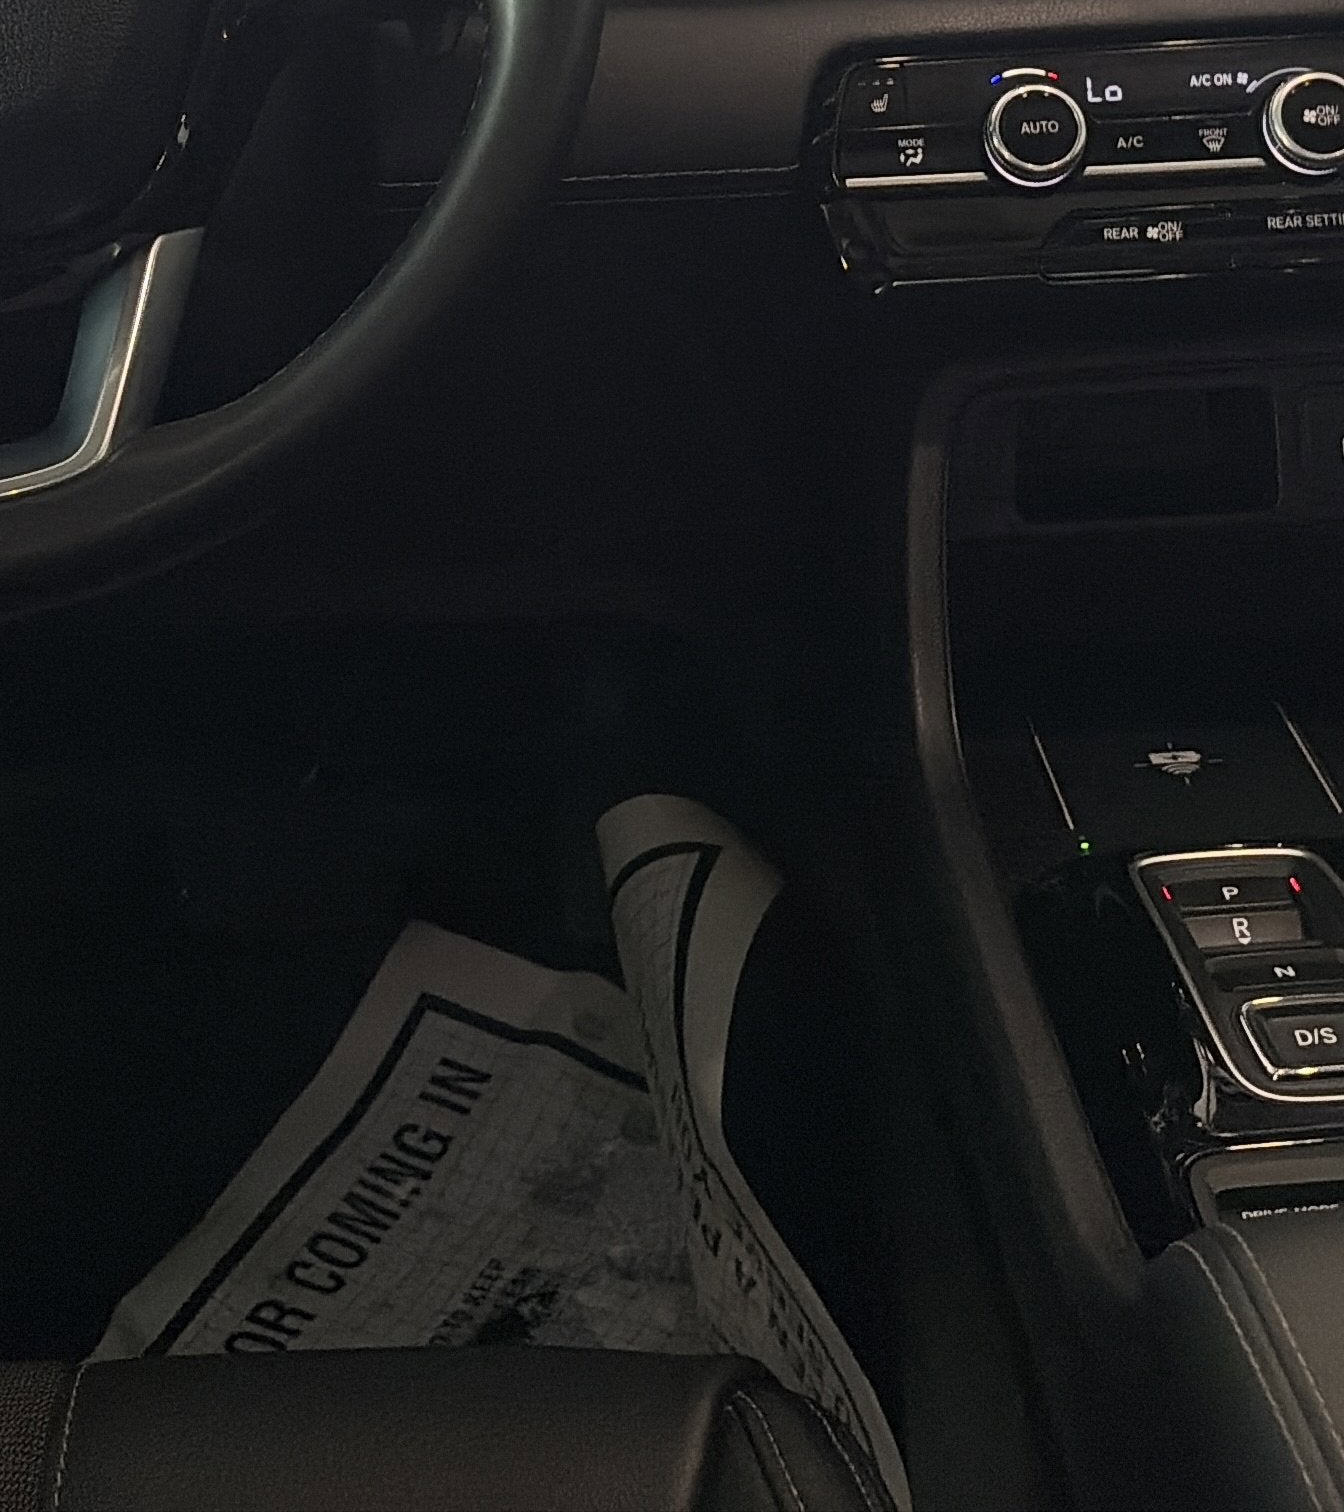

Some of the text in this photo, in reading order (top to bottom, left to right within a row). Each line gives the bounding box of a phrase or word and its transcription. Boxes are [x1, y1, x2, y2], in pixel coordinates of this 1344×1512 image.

[1189, 72, 1232, 88] A/C ON
[1086, 76, 1123, 103] Lo
[1316, 103, 1339, 116] ON/
[1318, 114, 1341, 127] OFF
[1020, 120, 1059, 136] AUTO
[1198, 127, 1228, 137] FRONT
[897, 138, 925, 148] MODE
[1116, 136, 1145, 149] A/C
[1158, 220, 1183, 232] ON/
[1267, 215, 1302, 230] REAR
[1103, 226, 1139, 240] REAR
[1159, 230, 1184, 243] OFF
[1221, 886, 1240, 901] P
[1232, 917, 1252, 938] R
[1273, 965, 1296, 978] N
[1294, 1027, 1338, 1047] D/S
[287, 1123, 453, 1294] COMING
[418, 1057, 493, 1116] IN
